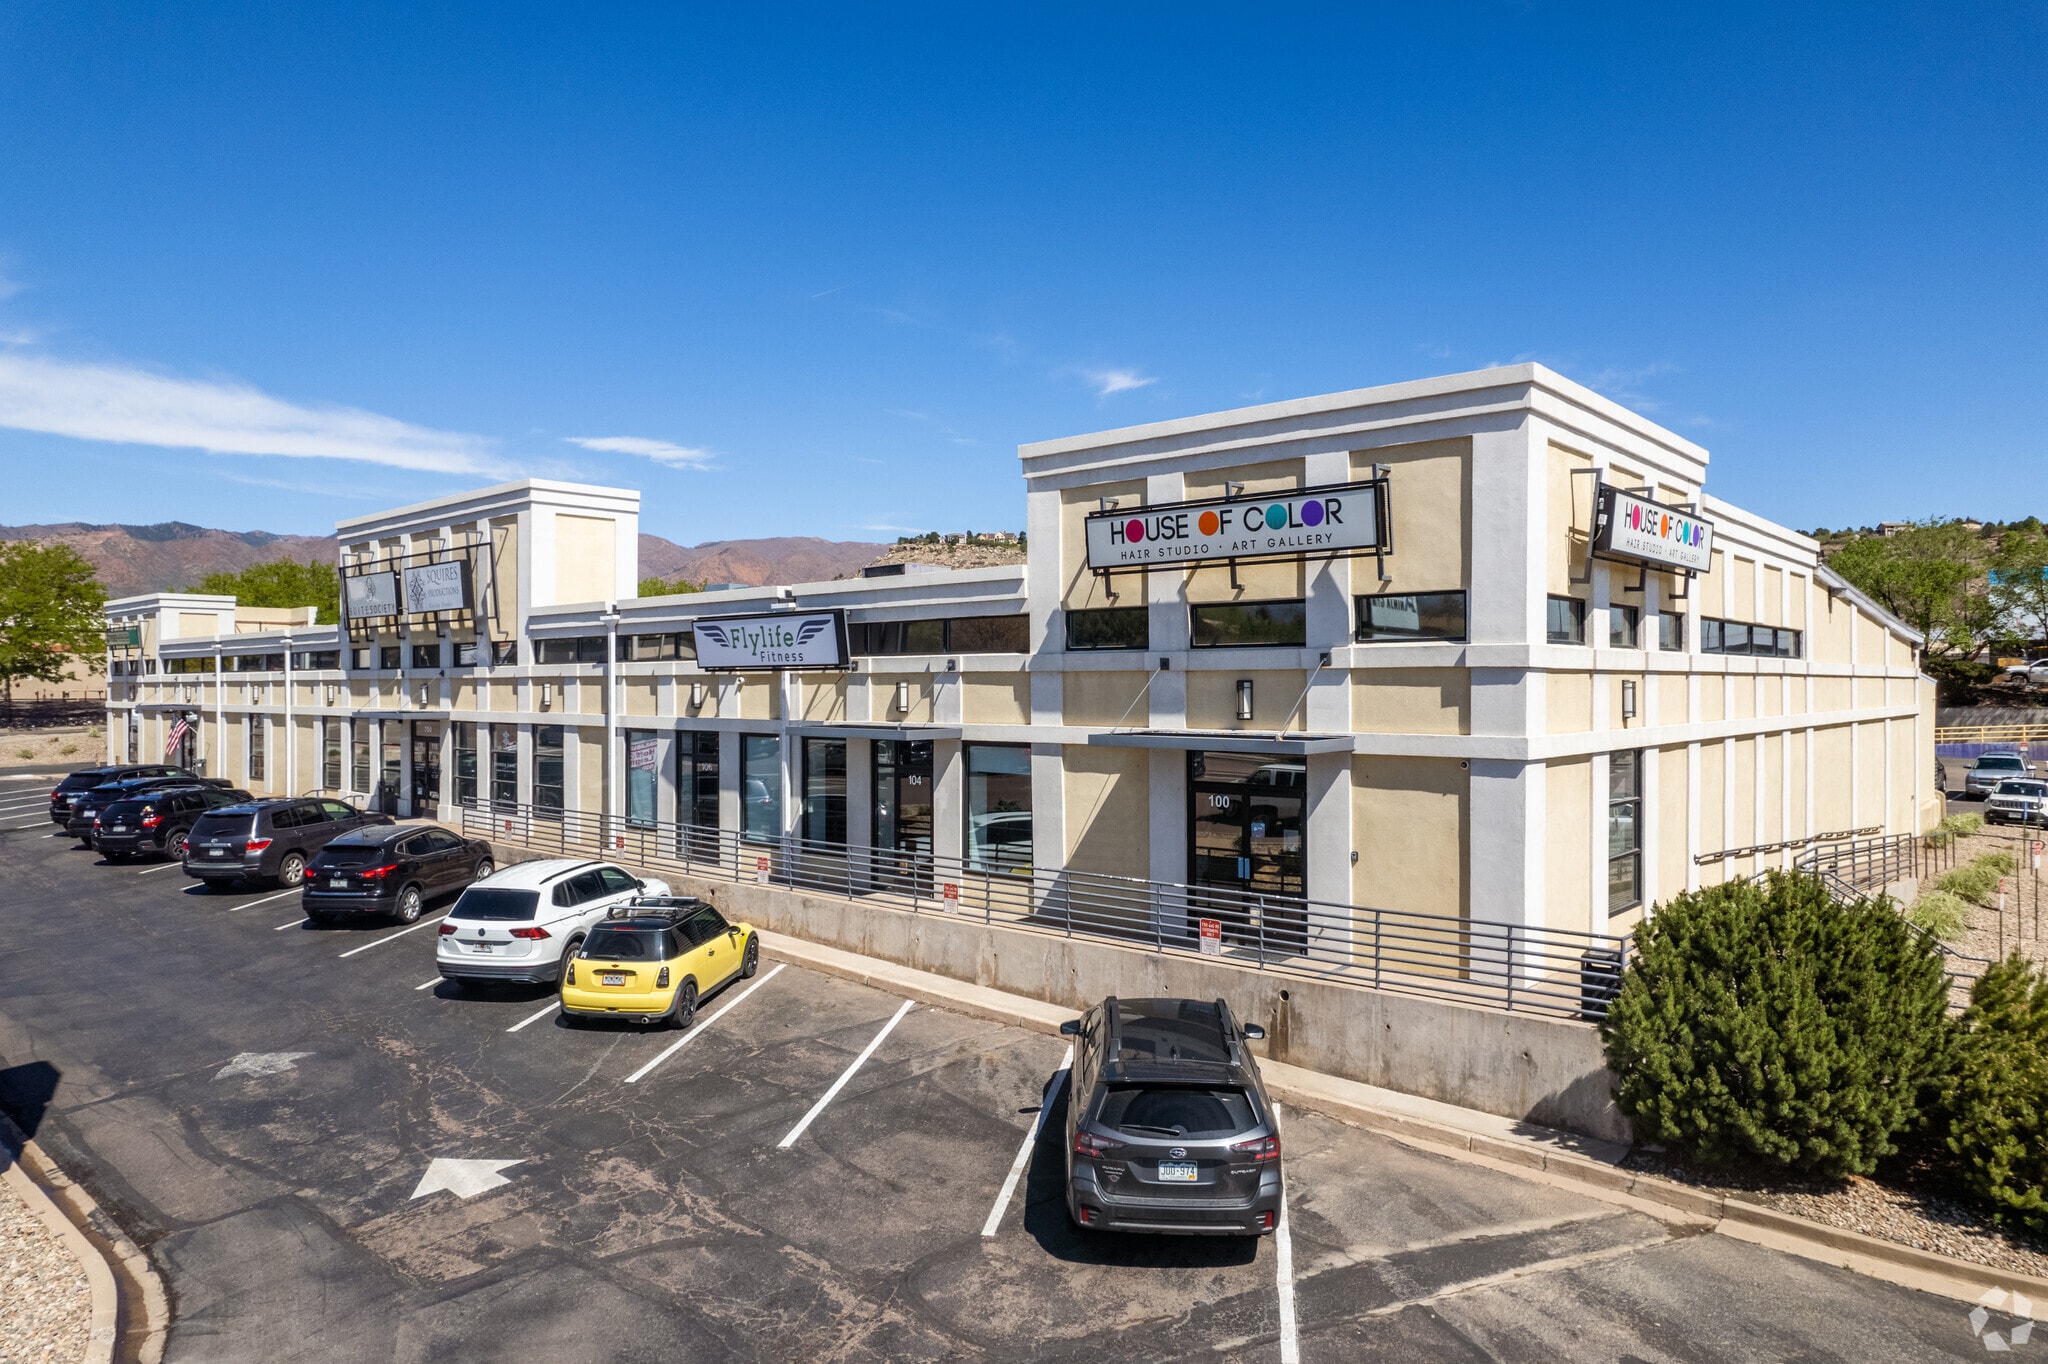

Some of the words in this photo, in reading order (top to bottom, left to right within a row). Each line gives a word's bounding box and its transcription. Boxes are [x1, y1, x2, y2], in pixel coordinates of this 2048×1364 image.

[1110, 514, 1189, 545] HOUSE
[1198, 509, 1232, 536] OF
[1243, 498, 1344, 532] COLOR
[1624, 502, 1658, 536] HOUSE
[1660, 513, 1673, 539] OF
[1675, 519, 1704, 549] COLOR
[1121, 549, 1150, 560] HAIR
[1159, 544, 1209, 557] STUDIO
[1232, 540, 1257, 551] ART
[1267, 533, 1332, 548] GALLERY
[1625, 537, 1640, 549] HAIR
[1642, 541, 1662, 555] STUDIO
[1669, 549, 1678, 558] ART
[426, 566, 458, 586] SQUIRES
[730, 625, 794, 656] Flylife
[760, 651, 804, 662] Fitness
[908, 775, 922, 786] 104
[1208, 795, 1230, 808] 100
